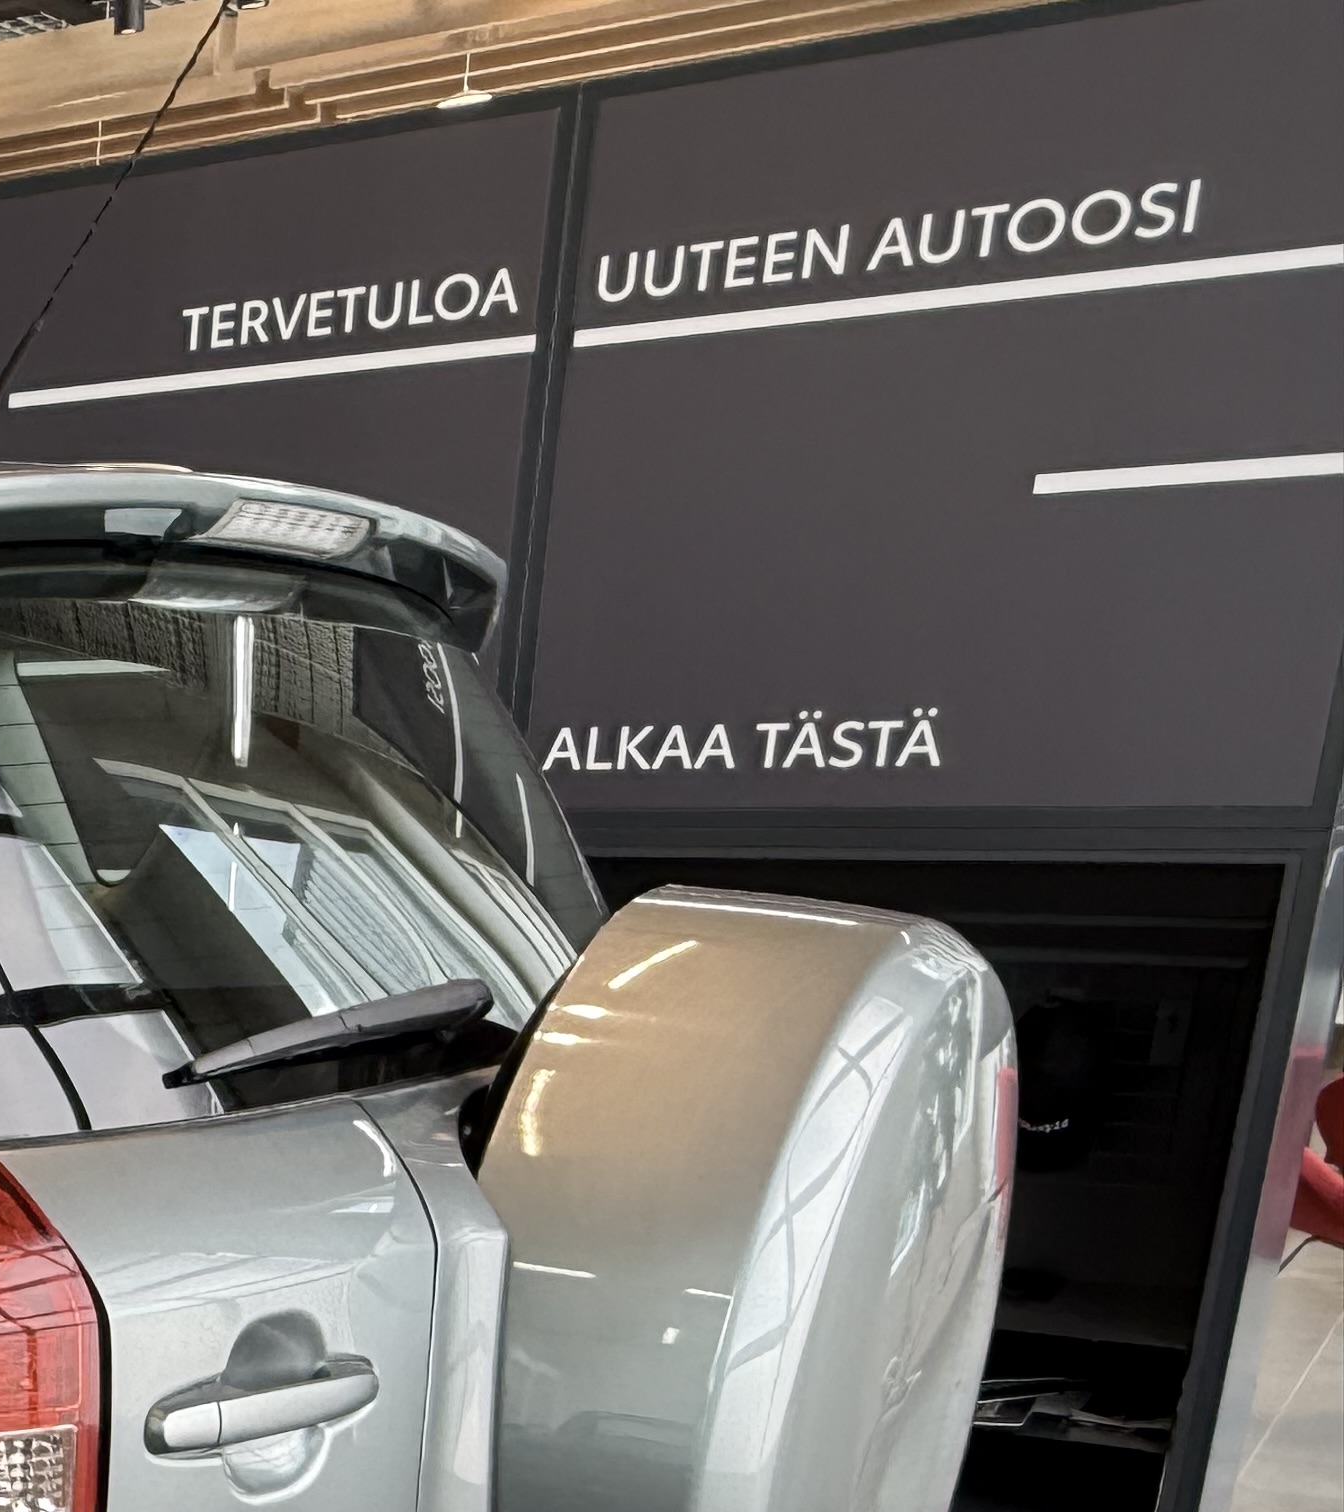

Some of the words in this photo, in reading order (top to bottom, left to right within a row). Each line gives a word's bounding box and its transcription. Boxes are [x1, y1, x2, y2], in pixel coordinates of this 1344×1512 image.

[182, 267, 519, 352] TERVETULOA
[597, 224, 850, 303] UUTEEN
[866, 178, 1203, 271] AUTOOSI
[541, 723, 736, 771] ALKAA
[755, 706, 941, 769] TÄSTÄ
